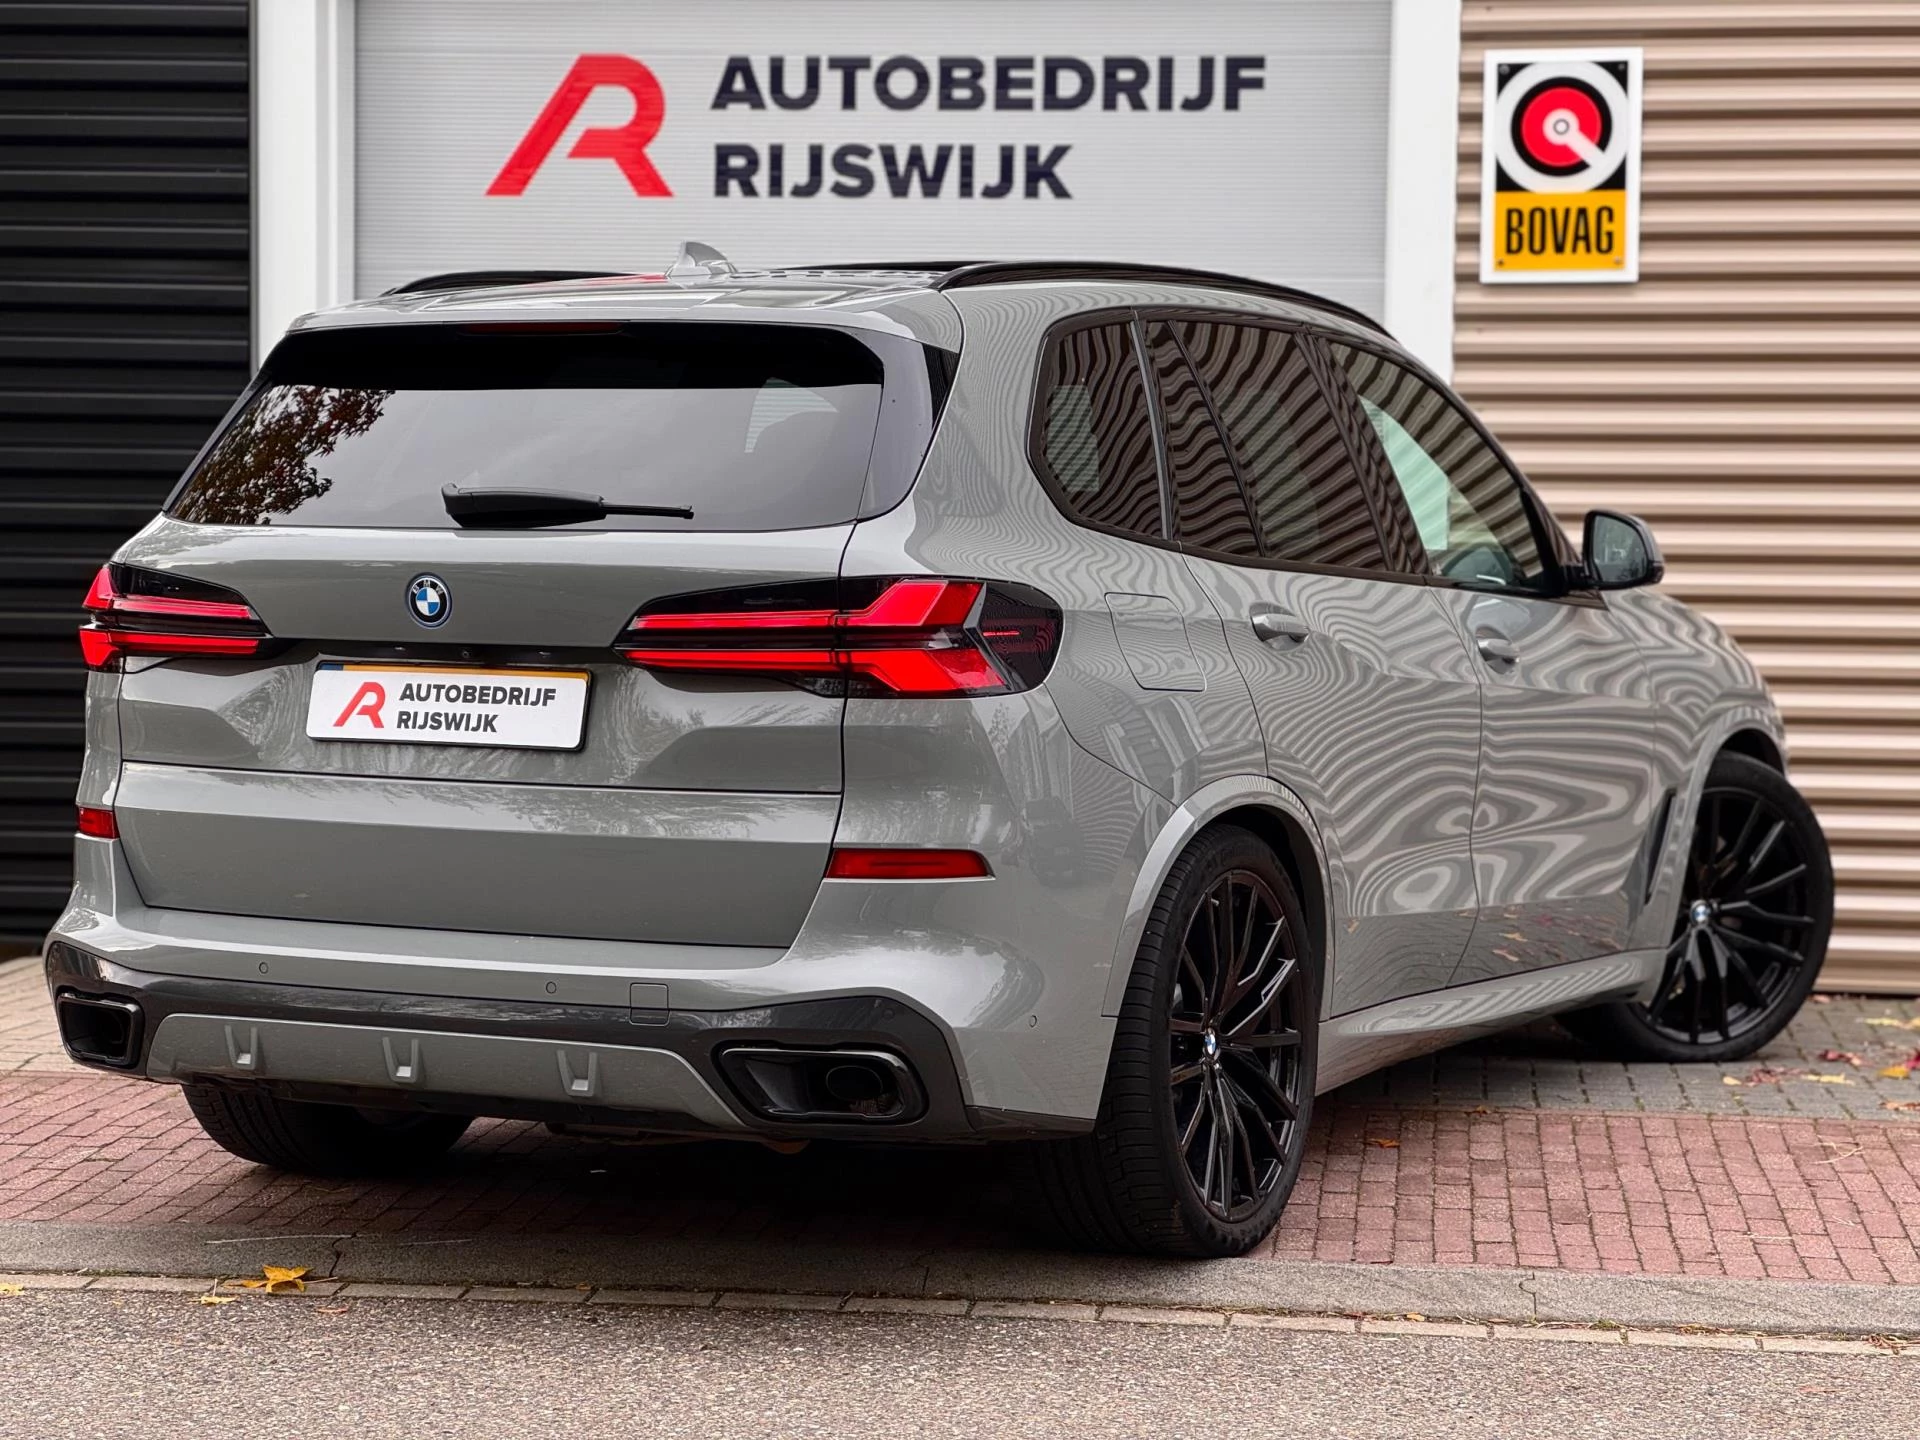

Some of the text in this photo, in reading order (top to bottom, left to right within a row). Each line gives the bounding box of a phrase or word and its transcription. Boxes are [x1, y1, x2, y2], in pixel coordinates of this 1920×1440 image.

[711, 55, 1266, 112] AUTOBEDRIJF
[713, 143, 1074, 199] RIJSWIJK
[1505, 206, 1614, 255] BOVAG
[399, 683, 556, 707] AUTOBEDRIJF
[396, 711, 498, 733] RIJSWIJK
